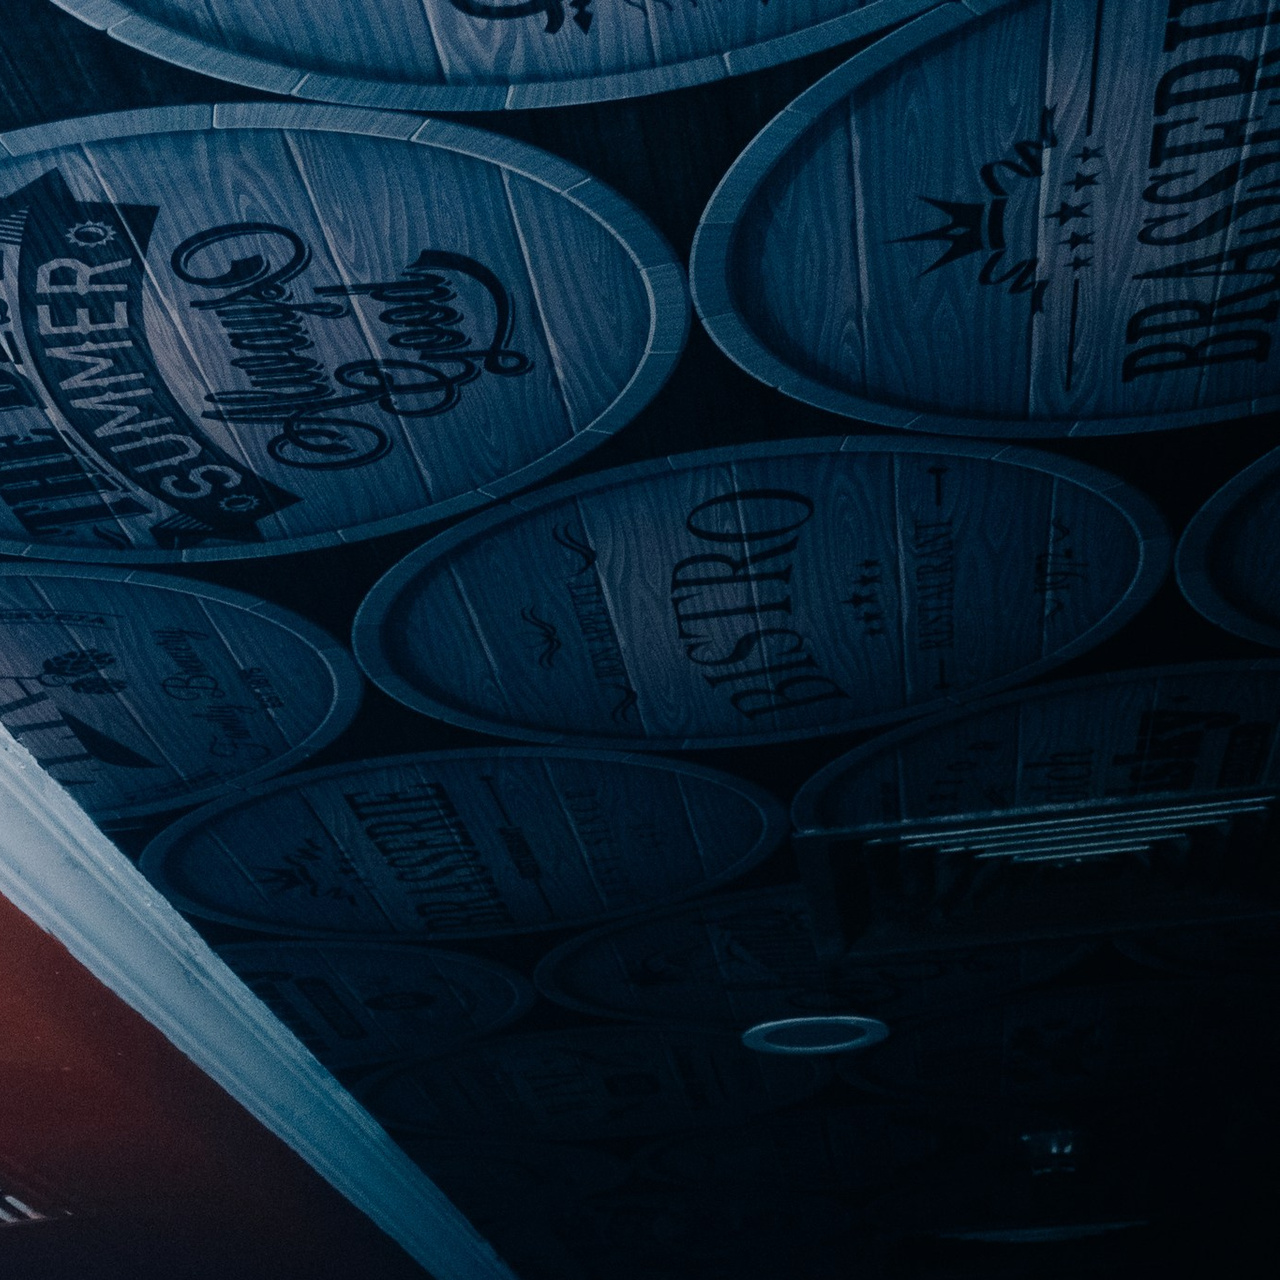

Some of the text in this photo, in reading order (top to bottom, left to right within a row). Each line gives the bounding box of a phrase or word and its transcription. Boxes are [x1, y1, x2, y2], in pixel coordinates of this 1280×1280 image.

[1122, 0, 1280, 383] BRASSERI
[35, 257, 243, 500] SUMMER
[669, 487, 850, 720] BISTRO
[913, 517, 956, 651] RESTAURANT
